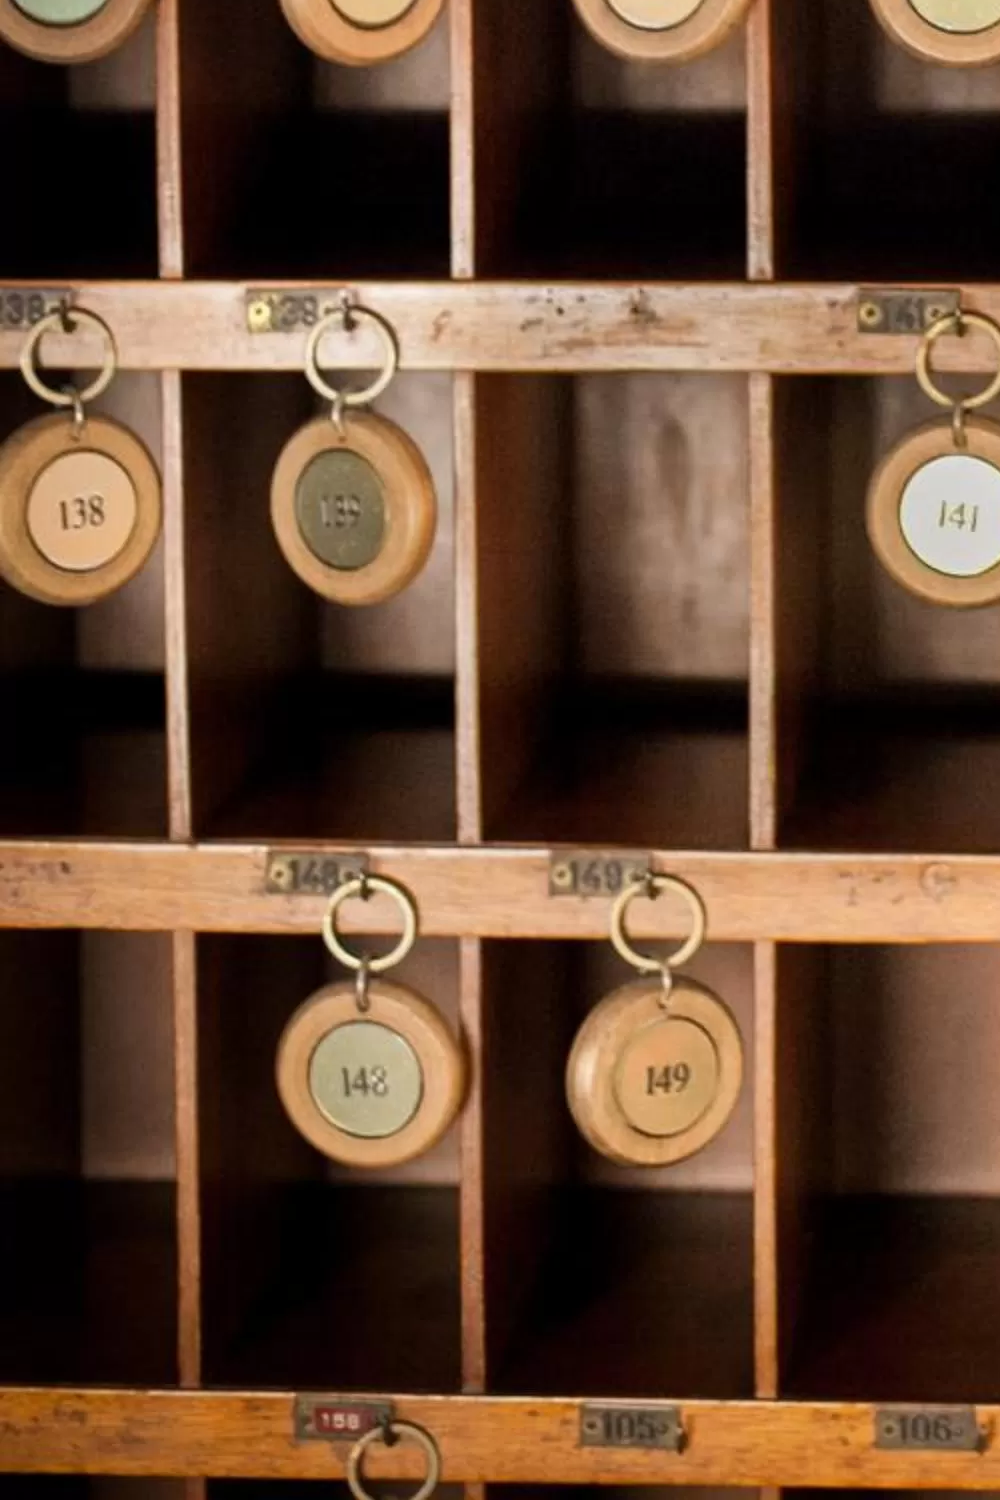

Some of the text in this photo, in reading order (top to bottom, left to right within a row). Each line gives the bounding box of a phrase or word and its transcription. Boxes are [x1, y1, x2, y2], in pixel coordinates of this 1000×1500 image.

[3, 293, 44, 324] 38
[59, 494, 105, 530] 138
[939, 500, 978, 532] 141
[289, 860, 339, 891] 148
[570, 861, 622, 892] 149
[342, 1066, 388, 1097] 148
[646, 1062, 691, 1095] 149
[603, 1411, 656, 1442] 105
[900, 1414, 952, 1443] 106
